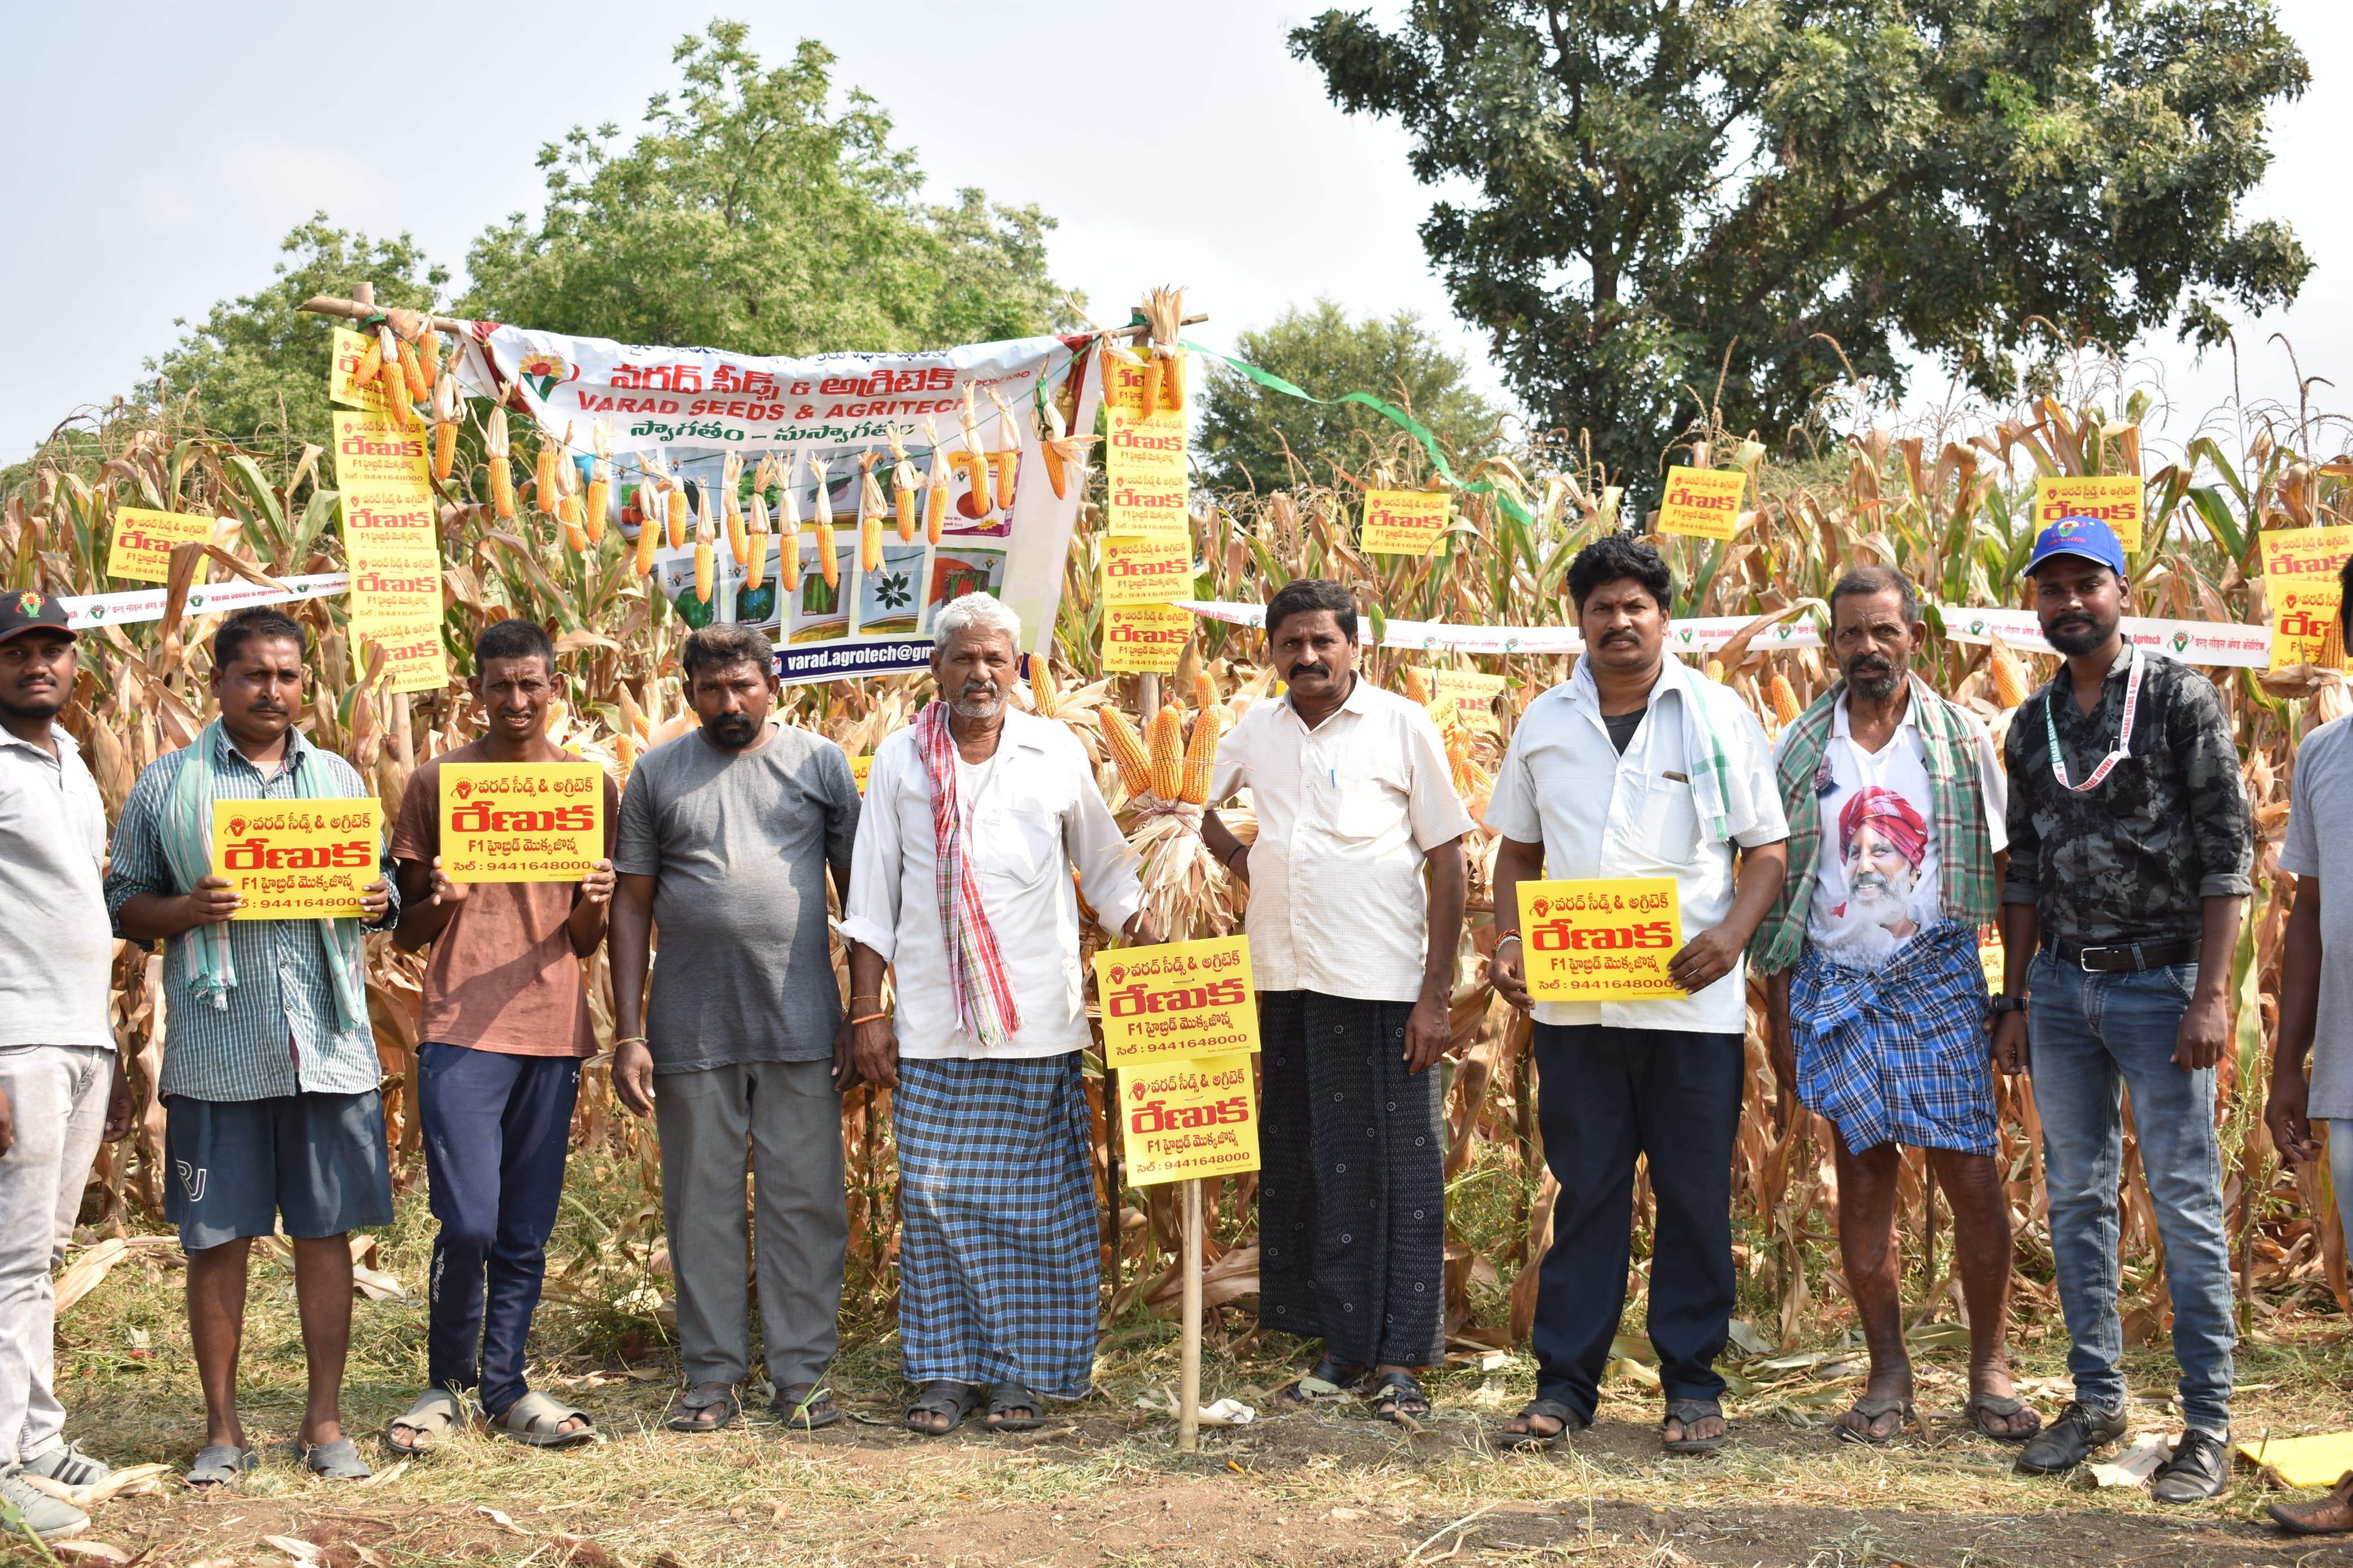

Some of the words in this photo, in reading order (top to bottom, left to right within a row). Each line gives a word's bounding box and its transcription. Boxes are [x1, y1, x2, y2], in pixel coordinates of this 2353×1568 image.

[611, 364, 701, 394] వరద్
[578, 391, 679, 414] VARAD
[688, 400, 786, 421] SEEDS
[795, 405, 815, 420] &
[631, 420, 744, 442] స్వాగతం
[1107, 558, 1187, 577] రేణుక
[1195, 607, 1210, 617] Seeds
[1109, 624, 1188, 643] రేణుక
[2133, 634, 2160, 645] Agritech
[384, 640, 439, 662] ణుక
[2126, 696, 2135, 715] SEEDS
[2047, 720, 2055, 740] SEEDS
[2122, 718, 2131, 738] VARAD
[2050, 740, 2060, 761] VARAD
[854, 767, 868, 779] రద్
[2097, 758, 2114, 777] VARAD
[479, 778, 509, 793] వరద్
[513, 776, 536, 797] సీడ్స్
[538, 779, 550, 793] &
[554, 777, 593, 797] అగ్రిటెక్
[253, 815, 285, 831] వరద్
[288, 813, 312, 833] సీడ్స్
[314, 815, 327, 830] &
[330, 814, 370, 833] అగ్రిటెక్
[452, 801, 594, 832] రేణుక
[225, 839, 371, 870] రేణుక
[469, 840, 483, 852] F1
[488, 838, 520, 856] హైబ్రిడ్
[523, 837, 578, 855] మొక్కజొన్న
[454, 861, 475, 870] సెల్
[488, 862, 591, 870] 9441648000
[243, 877, 257, 889] F1
[262, 875, 295, 893] హైబ్రిడ్
[298, 874, 354, 891] మొక్కజొన్న
[261, 898, 360, 908] 944164800
[1556, 895, 1585, 911] వరద్
[1588, 893, 1612, 914] సీడ్స్
[1613, 895, 1626, 910] &
[1629, 893, 1668, 914] అగ్రిటెక్
[1532, 919, 1673, 951] రేణుక
[1132, 960, 1160, 977] వరద్
[1163, 957, 1186, 975] సీడ్స్
[1187, 956, 1200, 971] &
[1202, 951, 1240, 973] అగ్రిటెక్
[1551, 958, 1566, 970] F1
[1569, 956, 1601, 974] హైబ్రిడ్
[1605, 955, 1658, 973] మొక్కజొన్న
[1539, 979, 1559, 989] సెల్
[1571, 979, 1673, 988] 9441648000
[1110, 978, 1246, 1017] రేణుక
[1128, 1022, 1142, 1035] F1
[1145, 1017, 1177, 1038] హైబ్రిడ్
[1180, 1012, 1233, 1031] మొక్కజొన్న
[1117, 1044, 1136, 1055] సెల్
[1148, 1035, 1247, 1052] 9441648000
[1152, 1076, 1176, 1093] వరద్
[1179, 1074, 1199, 1092] సీడ్స్
[1200, 1073, 1210, 1088] &
[1213, 1069, 1244, 1090] అగ్రిటెక్
[1131, 1096, 1248, 1134] రేణుక
[1148, 1139, 1160, 1152] F1
[1163, 1135, 1191, 1155] హైబ్రిడ్
[1193, 1129, 1238, 1149] మొక్కజొన్న
[1137, 1162, 1155, 1173] సెల్
[1165, 1152, 1249, 1169] 9441648000
